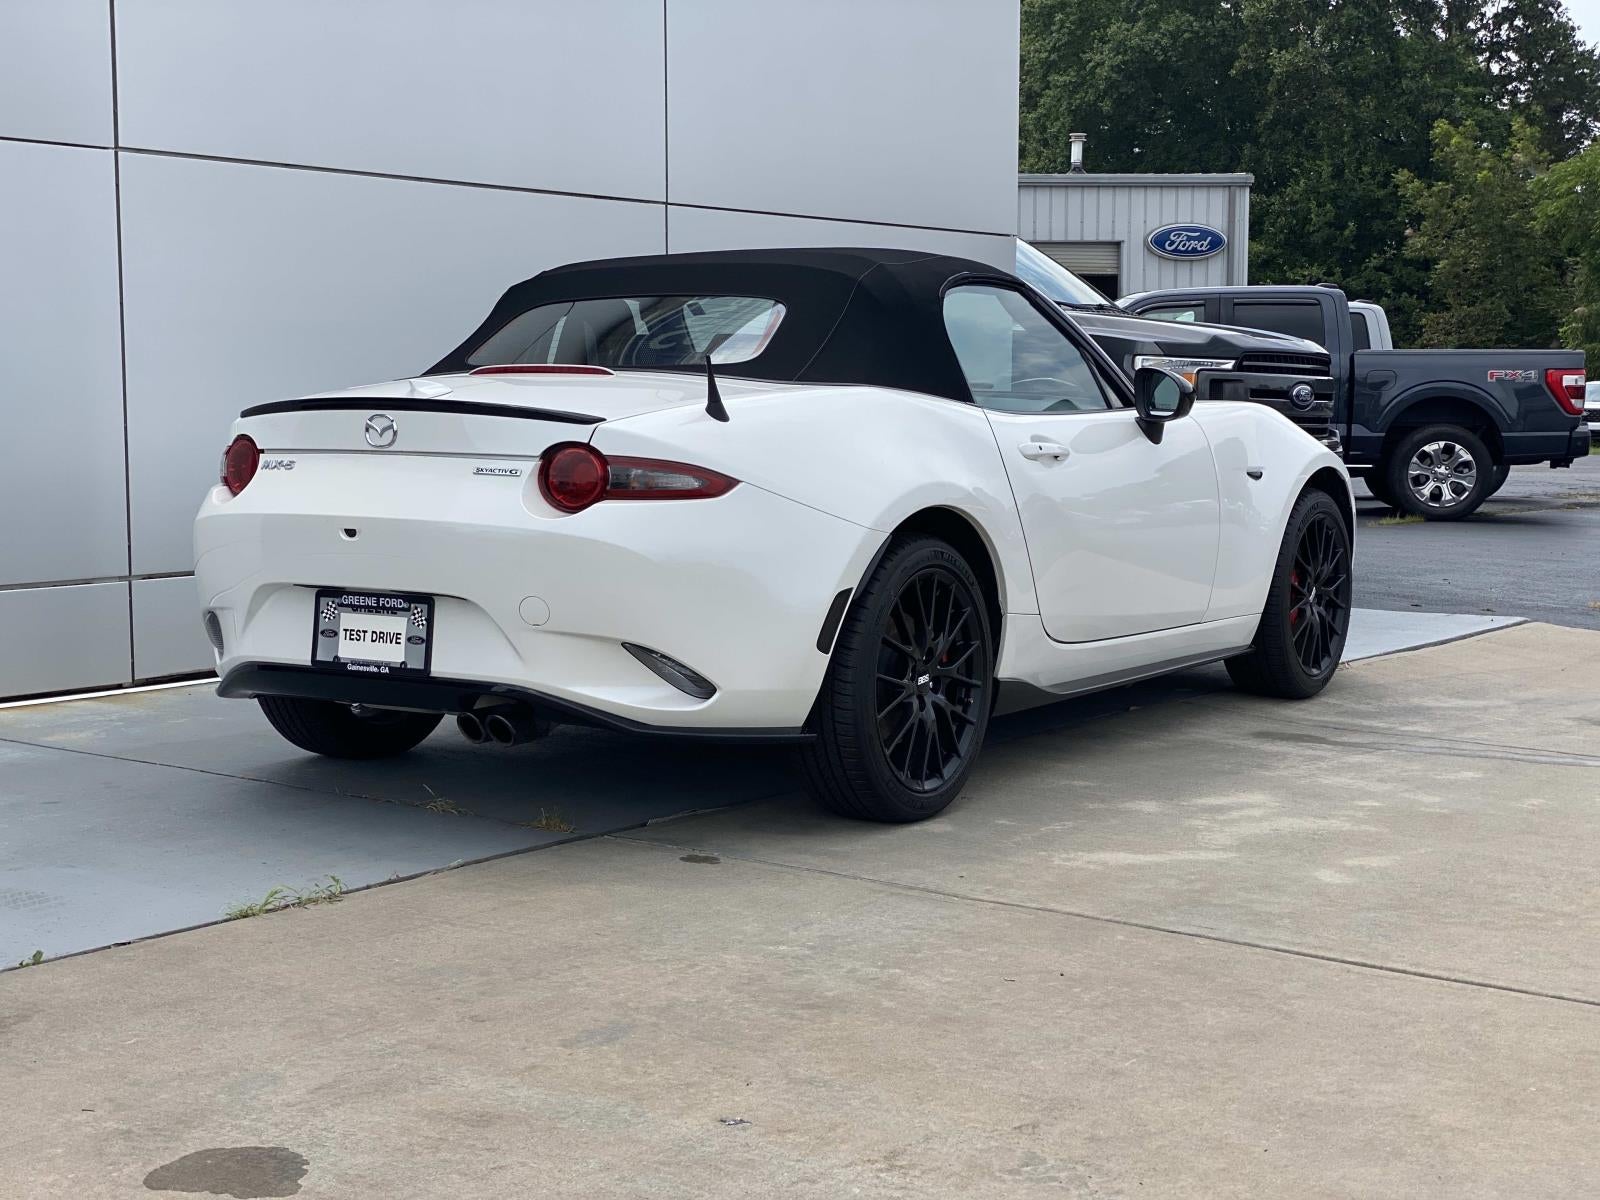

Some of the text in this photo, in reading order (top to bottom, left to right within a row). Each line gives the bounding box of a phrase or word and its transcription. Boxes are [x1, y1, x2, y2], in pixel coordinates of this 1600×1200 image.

[1164, 230, 1212, 251] Ford
[1487, 370, 1538, 383] FX4
[260, 459, 297, 471] MX-5
[341, 594, 404, 609] GREENE FORD
[343, 628, 402, 645] TEST DRIVE
[379, 666, 390, 674] GA
[917, 673, 930, 686] BBS
